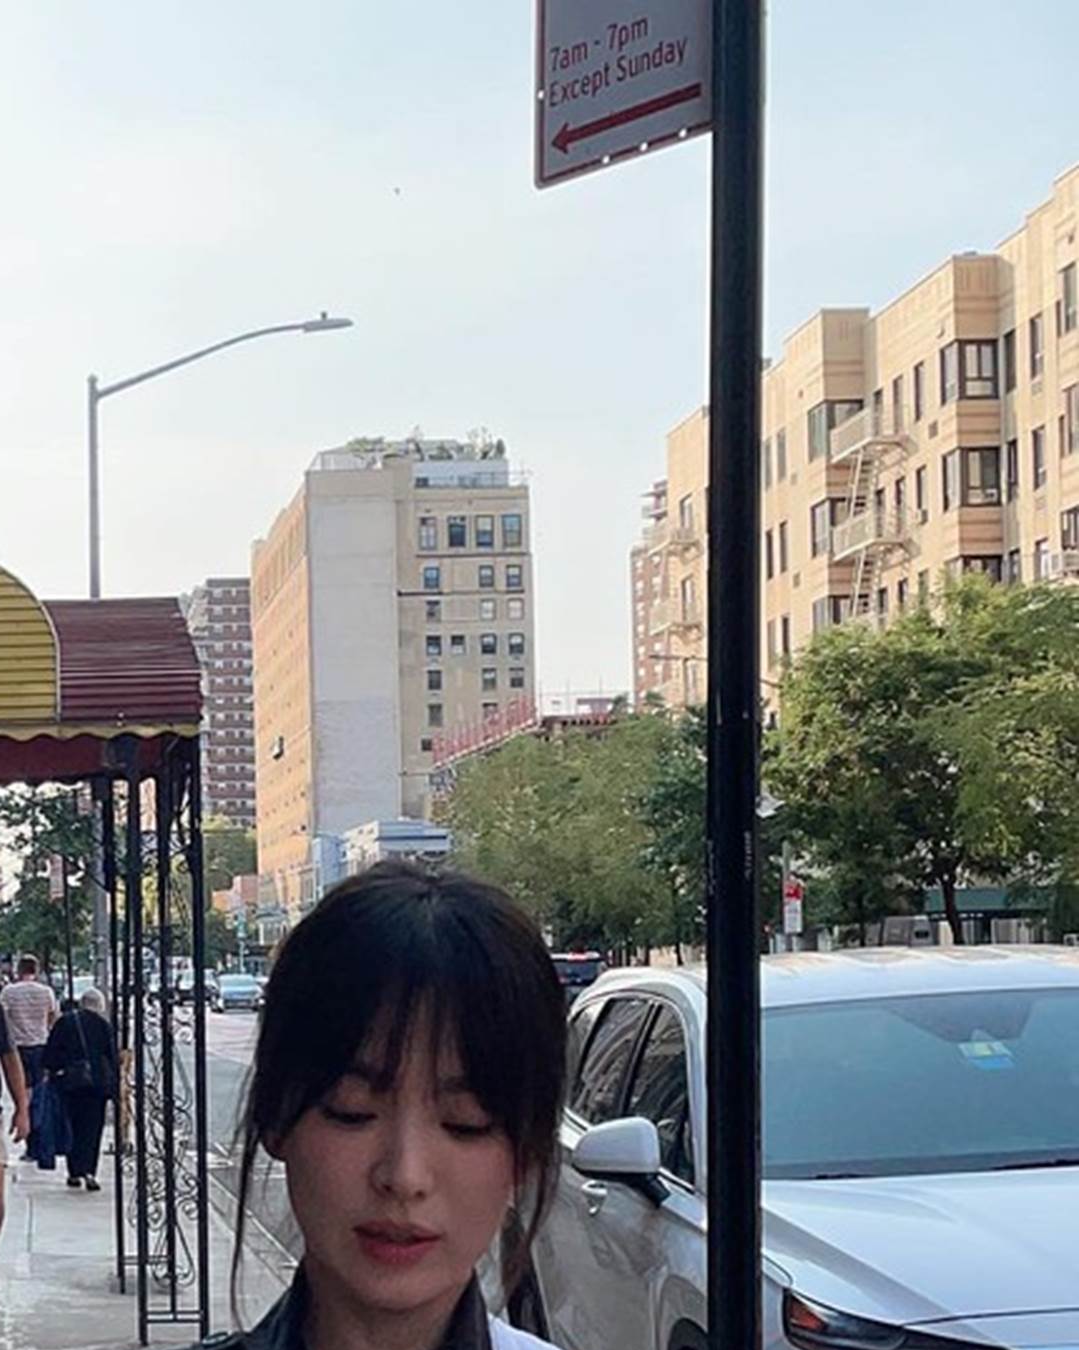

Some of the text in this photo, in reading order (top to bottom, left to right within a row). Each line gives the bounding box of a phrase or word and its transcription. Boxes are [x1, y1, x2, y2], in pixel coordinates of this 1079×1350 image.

[549, 37, 689, 108] Except Sunday
[550, 42, 589, 71] 7am
[607, 17, 649, 52] 7pm
